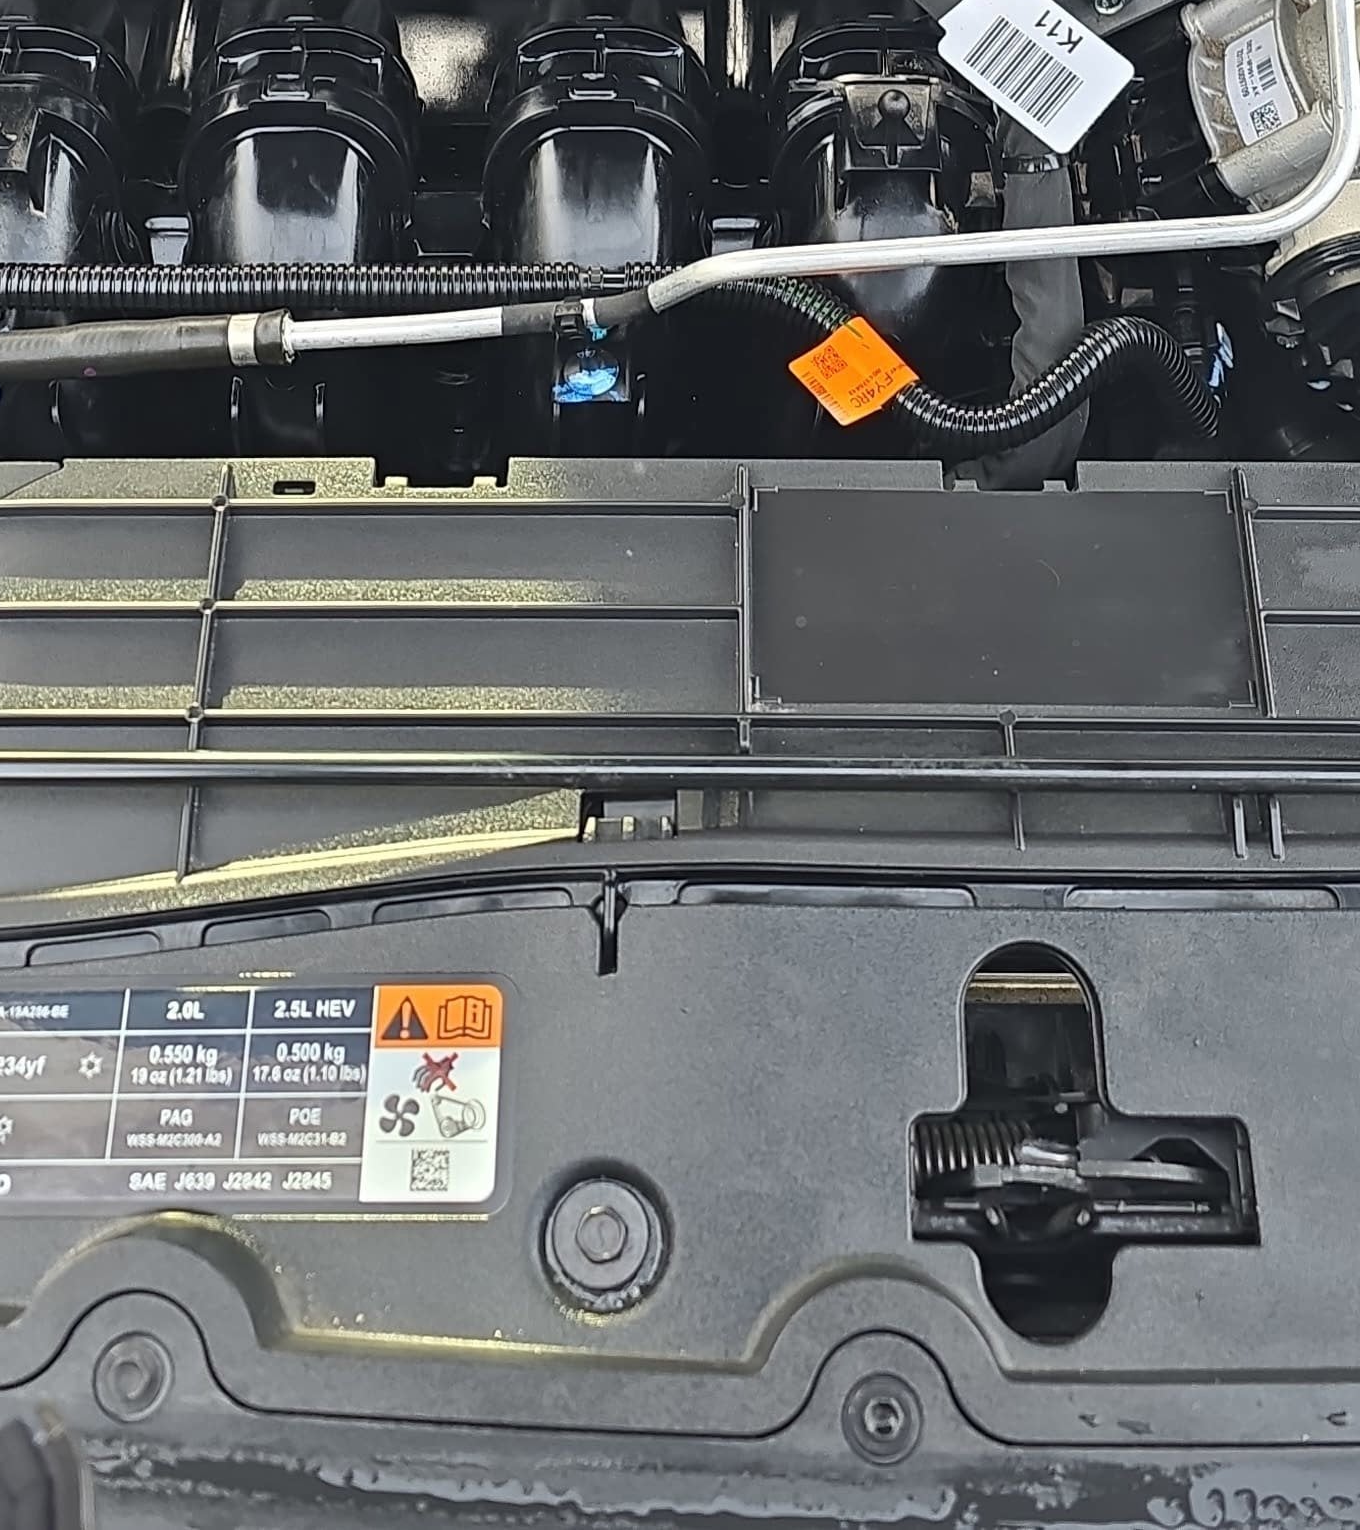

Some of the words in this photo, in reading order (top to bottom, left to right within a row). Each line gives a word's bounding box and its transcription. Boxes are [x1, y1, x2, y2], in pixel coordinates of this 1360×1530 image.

[1033, 9, 1083, 52] K11
[850, 372, 894, 408] FY4RC
[165, 1000, 205, 1020] 2.0L
[273, 1000, 313, 1019] 2.5L
[316, 999, 356, 1018] HEV
[148, 1045, 195, 1064] 0.550
[196, 1043, 218, 1066] kg
[276, 1042, 321, 1062] 0.500
[323, 1042, 346, 1064] kg
[149, 1070, 167, 1084] oz
[205, 1066, 233, 1086] lbs)
[283, 1068, 301, 1082] oz
[339, 1064, 367, 1085] lbs)
[159, 1108, 193, 1127] PAG
[289, 1107, 322, 1126] POE
[128, 1171, 168, 1191] SAE
